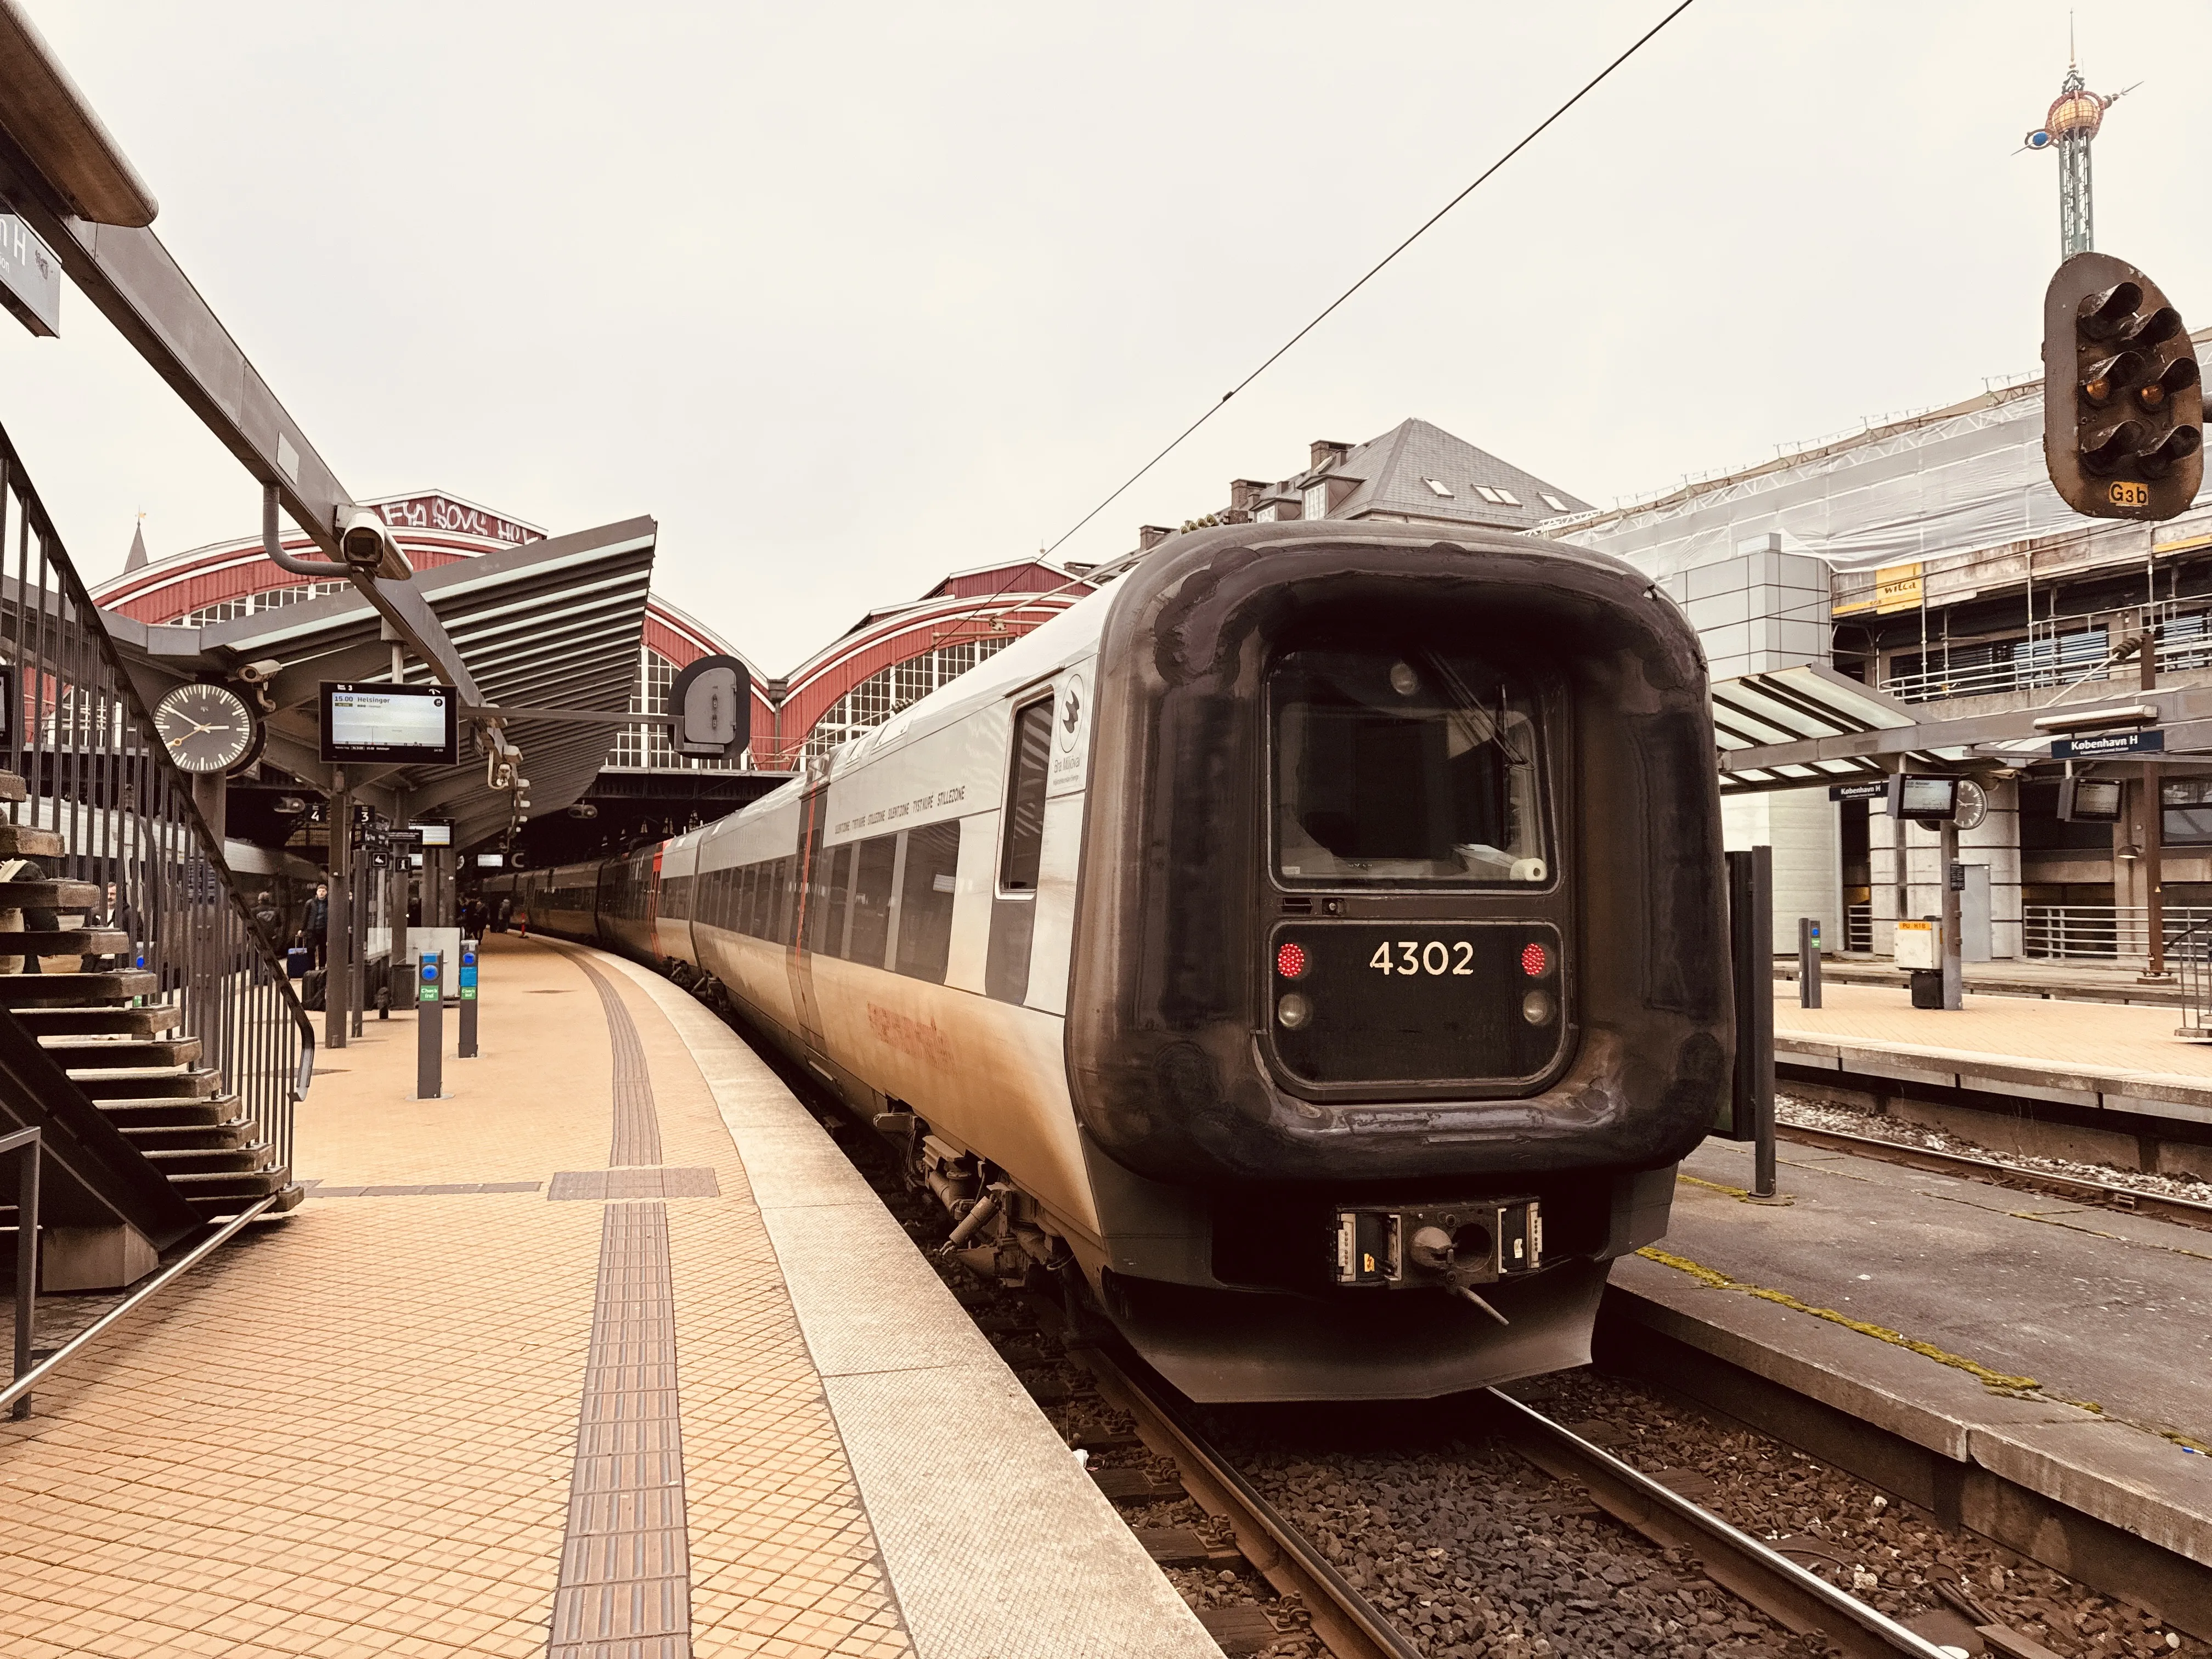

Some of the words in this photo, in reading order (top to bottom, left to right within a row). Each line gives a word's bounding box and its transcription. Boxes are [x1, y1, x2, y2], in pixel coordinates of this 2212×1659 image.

[14, 224, 26, 266] H
[2111, 483, 2147, 504] G3b
[2071, 737, 2128, 751] København
[2129, 735, 2138, 745] H
[311, 811, 319, 821] 4
[362, 811, 369, 822] 3
[511, 853, 524, 868] C
[1369, 941, 1474, 975] 4302
